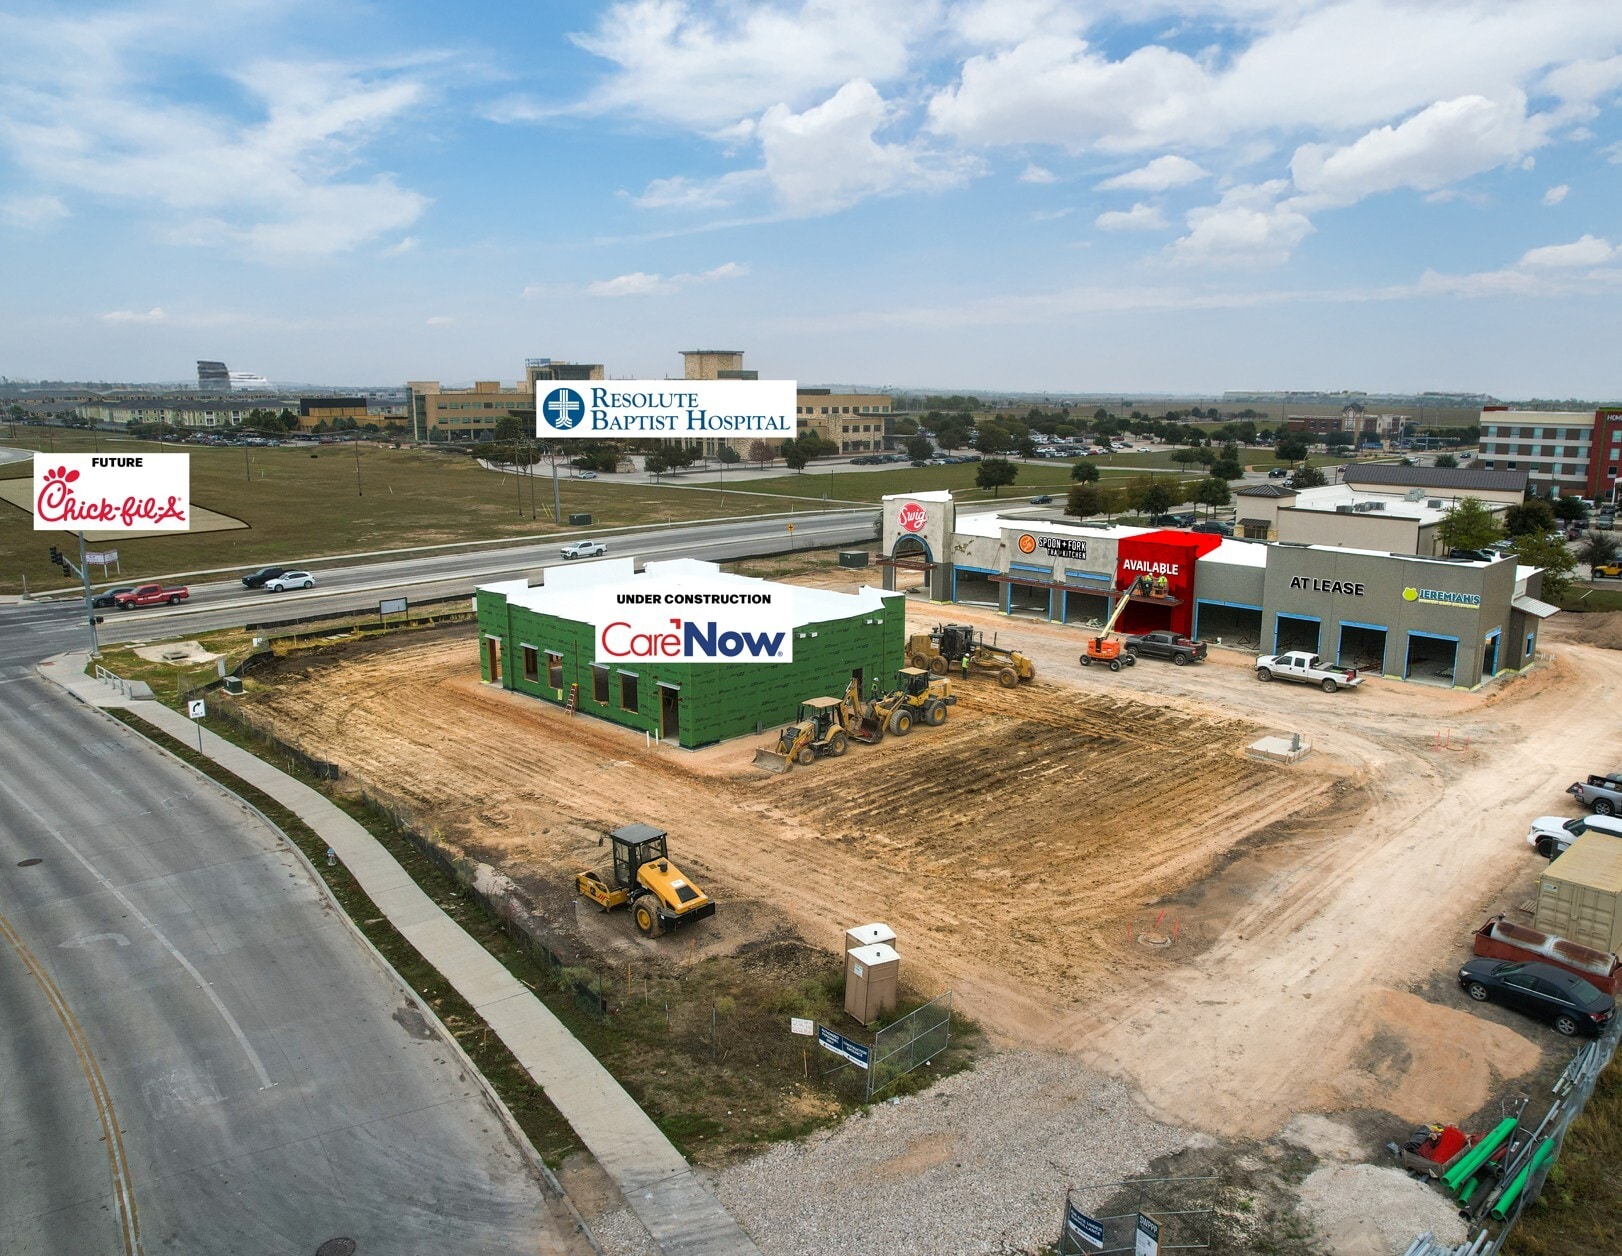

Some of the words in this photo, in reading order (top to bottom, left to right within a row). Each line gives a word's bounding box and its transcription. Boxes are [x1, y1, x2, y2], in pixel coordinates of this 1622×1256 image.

[898, 507, 927, 529] Swig
[1038, 537, 1061, 549] SPOON
[1067, 540, 1087, 552] FORK
[1062, 550, 1087, 560] KITCHEN
[1419, 588, 1481, 606] JEREMIAH'S
[1139, 1215, 1159, 1234] SWPPP
